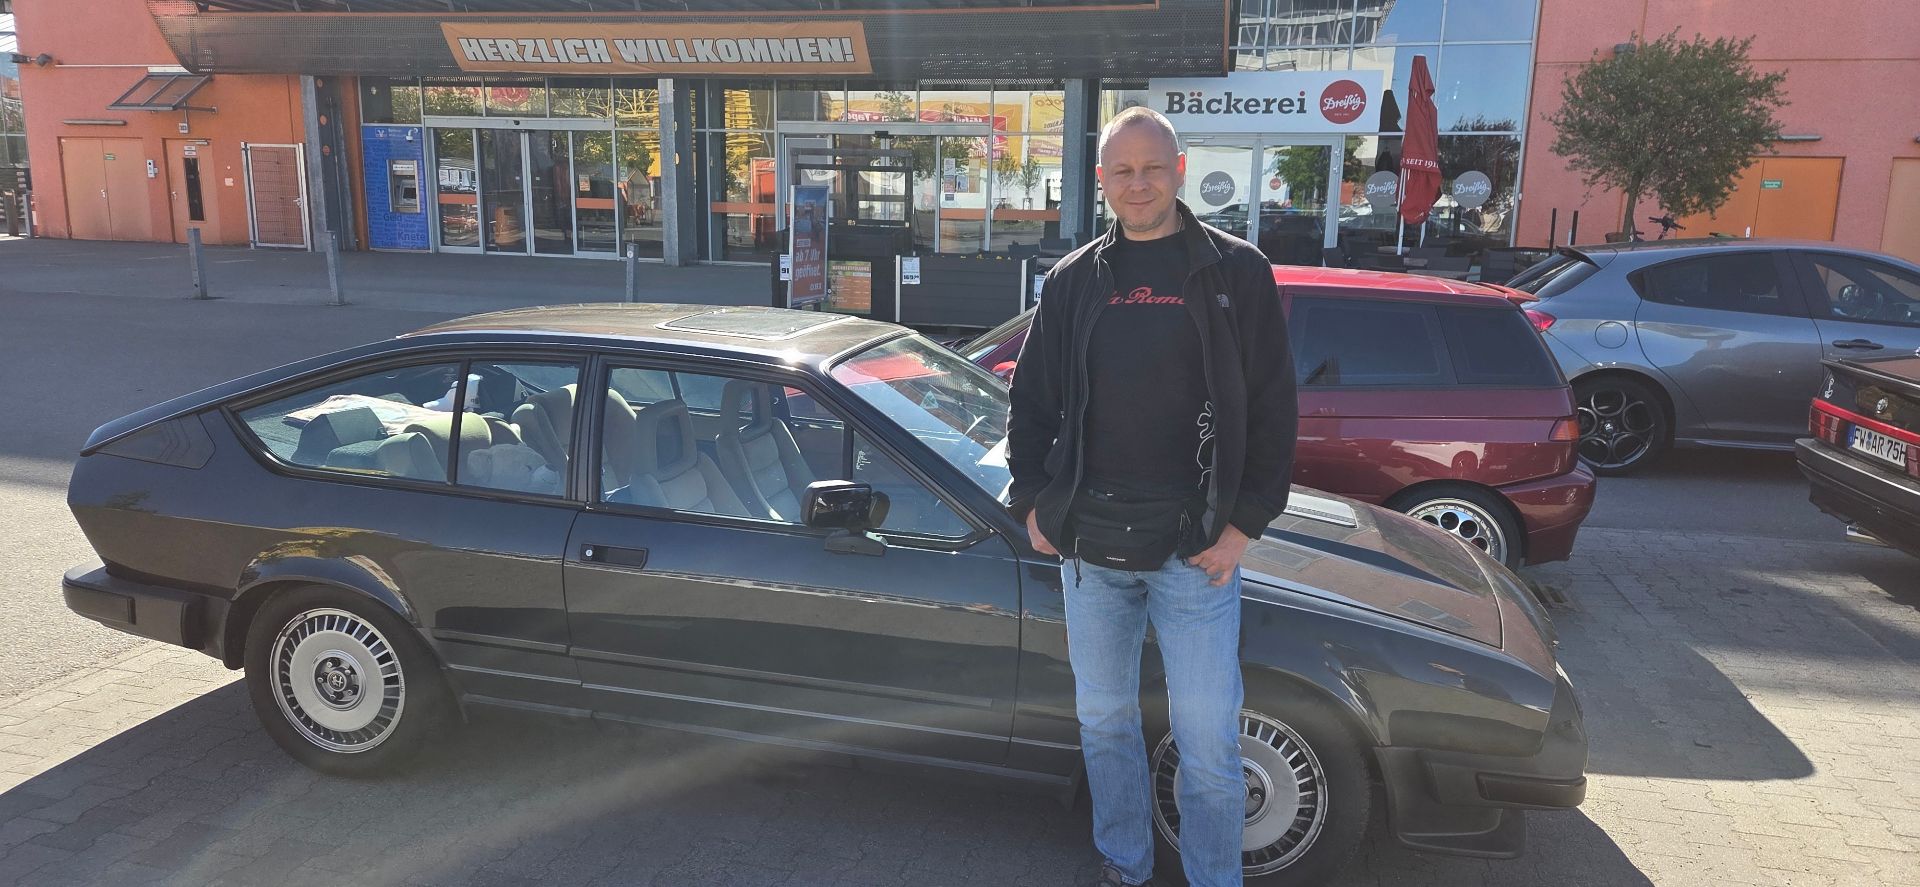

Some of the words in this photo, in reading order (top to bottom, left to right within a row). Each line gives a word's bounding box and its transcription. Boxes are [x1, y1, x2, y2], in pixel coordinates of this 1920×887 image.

[457, 37, 613, 63] HERZLICH
[613, 37, 856, 63] WILLKOMMEN!
[1165, 90, 1307, 114] Bäckerei
[1322, 93, 1365, 111] Dreißig
[1405, 158, 1424, 166] SEIT
[1201, 180, 1234, 194] Dreißig
[1454, 180, 1490, 195] Dreißig
[1854, 427, 1867, 448] FW
[1871, 434, 1885, 455] AR
[1886, 439, 1907, 463] 75H
